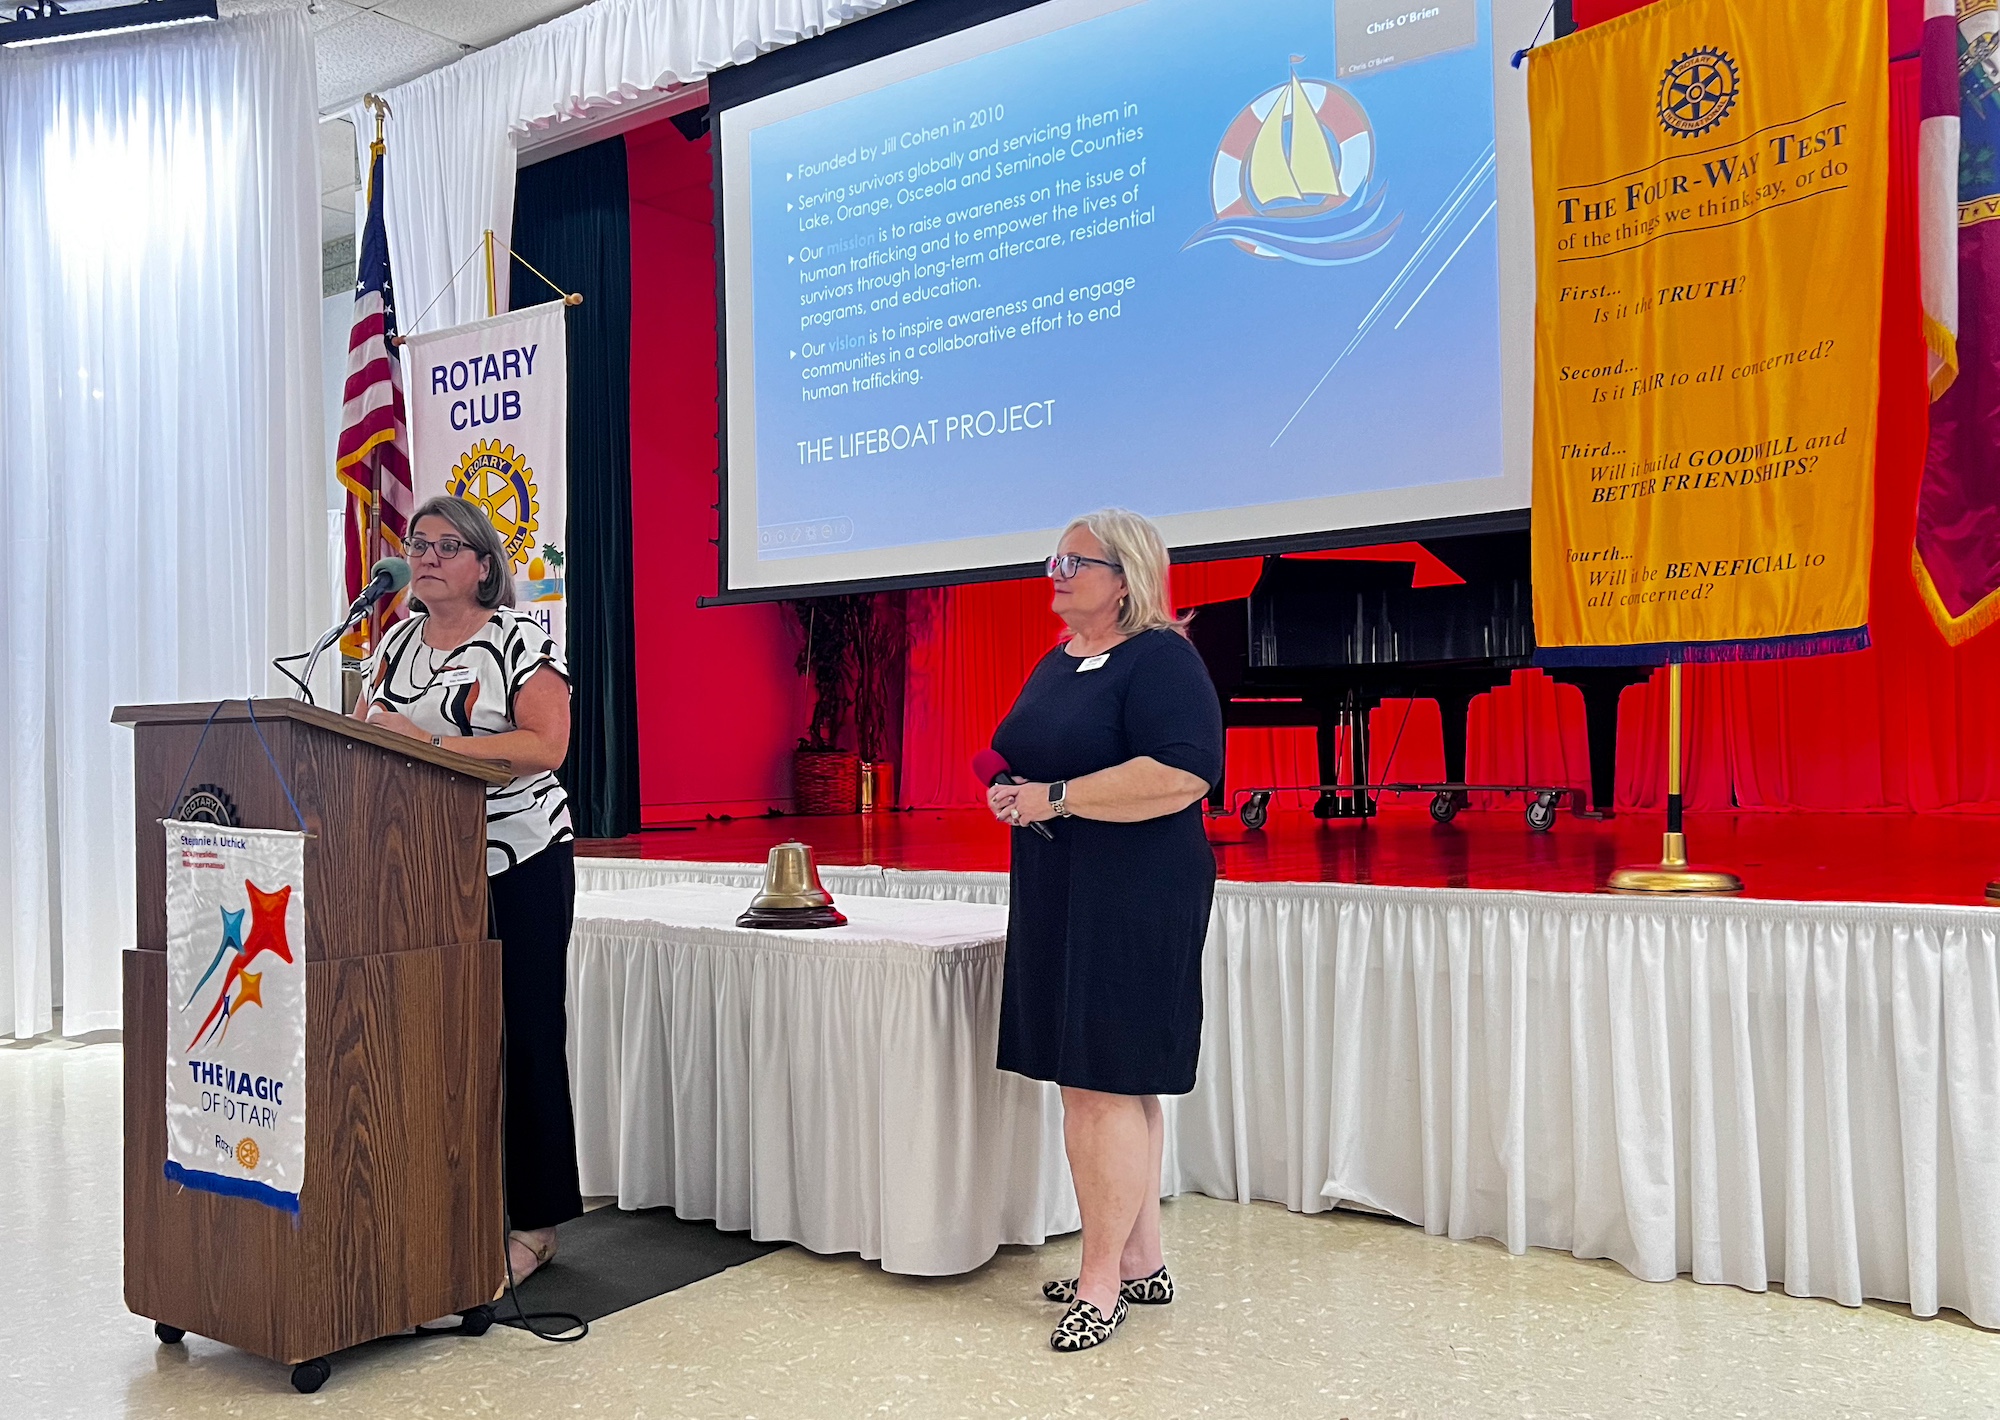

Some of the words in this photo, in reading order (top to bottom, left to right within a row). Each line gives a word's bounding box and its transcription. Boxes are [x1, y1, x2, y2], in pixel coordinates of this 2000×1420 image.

[1366, 18, 1395, 35] Chris
[1396, 6, 1440, 27] O'Brien
[1677, 56, 1712, 72] ROTARY
[1664, 99, 1728, 129] INTERNATIONAL
[798, 147, 857, 180] Founded
[860, 145, 878, 162] by
[880, 136, 897, 156] Jill
[899, 124, 949, 149] Cohen
[952, 117, 966, 134] in
[969, 103, 1005, 129] 2010
[798, 187, 846, 211] Serving
[848, 170, 905, 197] survivors
[907, 151, 965, 183] globally
[968, 138, 999, 163] and
[1003, 122, 1072, 153] servicing
[1076, 108, 1119, 132] them
[1123, 103, 1139, 119] in
[799, 212, 833, 233] Lake,
[836, 197, 893, 222] Orange,
[896, 176, 957, 205] Osceola
[960, 164, 991, 188] and
[995, 146, 1067, 179] Seminole
[1070, 126, 1144, 158] Counties
[1557, 197, 1617, 225] THE
[1768, 123, 1847, 167] TEST
[799, 246, 824, 263] Our
[826, 231, 876, 257] mission
[878, 227, 888, 243] is
[891, 223, 906, 240] to
[909, 215, 943, 235] raise
[945, 193, 1027, 225] awareness
[1029, 187, 1051, 203] on
[1055, 178, 1082, 197] the
[1085, 168, 1125, 189] issue
[1129, 156, 1147, 178] of
[1557, 232, 1577, 251] of
[1583, 230, 1611, 248] the
[1615, 214, 1661, 241] things
[1664, 207, 1692, 223] we
[1754, 180, 1786, 203] say,
[1795, 169, 1816, 188] or
[1820, 159, 1849, 179] do
[799, 262, 847, 285] human
[849, 245, 917, 273] trafficking
[920, 231, 951, 255] and
[954, 229, 970, 247] to
[973, 211, 1049, 242] empower
[1051, 203, 1079, 222] the
[1082, 194, 1117, 215] lives
[1121, 183, 1139, 205] of
[800, 283, 854, 307] survivors
[857, 266, 911, 293] through
[913, 251, 985, 279] long-term
[988, 233, 1066, 261] aftercare,
[1069, 205, 1155, 243] residential
[800, 303, 867, 332] programs,
[870, 290, 899, 312] and
[901, 276, 982, 305] education.
[801, 341, 826, 359] Our
[828, 333, 867, 354] vision
[869, 328, 879, 345] is
[881, 325, 896, 342] to
[899, 316, 944, 339] inspire
[947, 299, 1028, 329] awareness
[1031, 287, 1065, 310] and
[1068, 276, 1136, 302] engage
[1558, 284, 1621, 303] First...
[1593, 307, 1610, 324] Is
[1616, 303, 1628, 320] it
[1634, 296, 1653, 315] the
[1657, 275, 1747, 306] TRUTH?
[801, 351, 886, 380] communities
[889, 346, 901, 363] in
[904, 346, 915, 360] a
[918, 325, 1017, 357] collaborative
[1020, 311, 1063, 337] effort
[1066, 309, 1084, 327] to
[1087, 299, 1121, 323] end
[432, 343, 539, 396] ROTARY
[802, 382, 849, 402] human
[851, 367, 924, 393] trafficking.
[1559, 358, 1639, 382] Second...
[1591, 387, 1608, 404] Is
[1612, 384, 1625, 401] it
[1631, 372, 1665, 397] FAIR
[1669, 372, 1689, 387] to
[1695, 364, 1725, 383] all
[1731, 339, 1835, 380] concerned?
[450, 389, 522, 432] CLUB
[796, 436, 834, 465] THE
[839, 418, 939, 459] LIFEBOAT
[945, 399, 1056, 443] PROJECT
[467, 455, 508, 478] ROTARY
[1560, 441, 1627, 460] Third...
[1591, 462, 1627, 483] Will
[1630, 461, 1641, 478] it
[1643, 452, 1682, 475] build
[1687, 435, 1799, 468] GOODWILL
[1805, 426, 1848, 451] and
[1591, 478, 1657, 503] BETTER
[1661, 455, 1819, 493] FRIENDSHIPS?
[1589, 568, 1627, 587] Will
[1630, 568, 1639, 584] it
[1641, 565, 1658, 582] be
[1664, 552, 1798, 580] BENEFICIAL
[1804, 553, 1826, 568] to
[1587, 591, 1615, 608] all
[1619, 582, 1715, 606] concerned?
[184, 797, 218, 817] ROTARY
[188, 1060, 224, 1088] THE
[201, 1091, 221, 1113] OF
